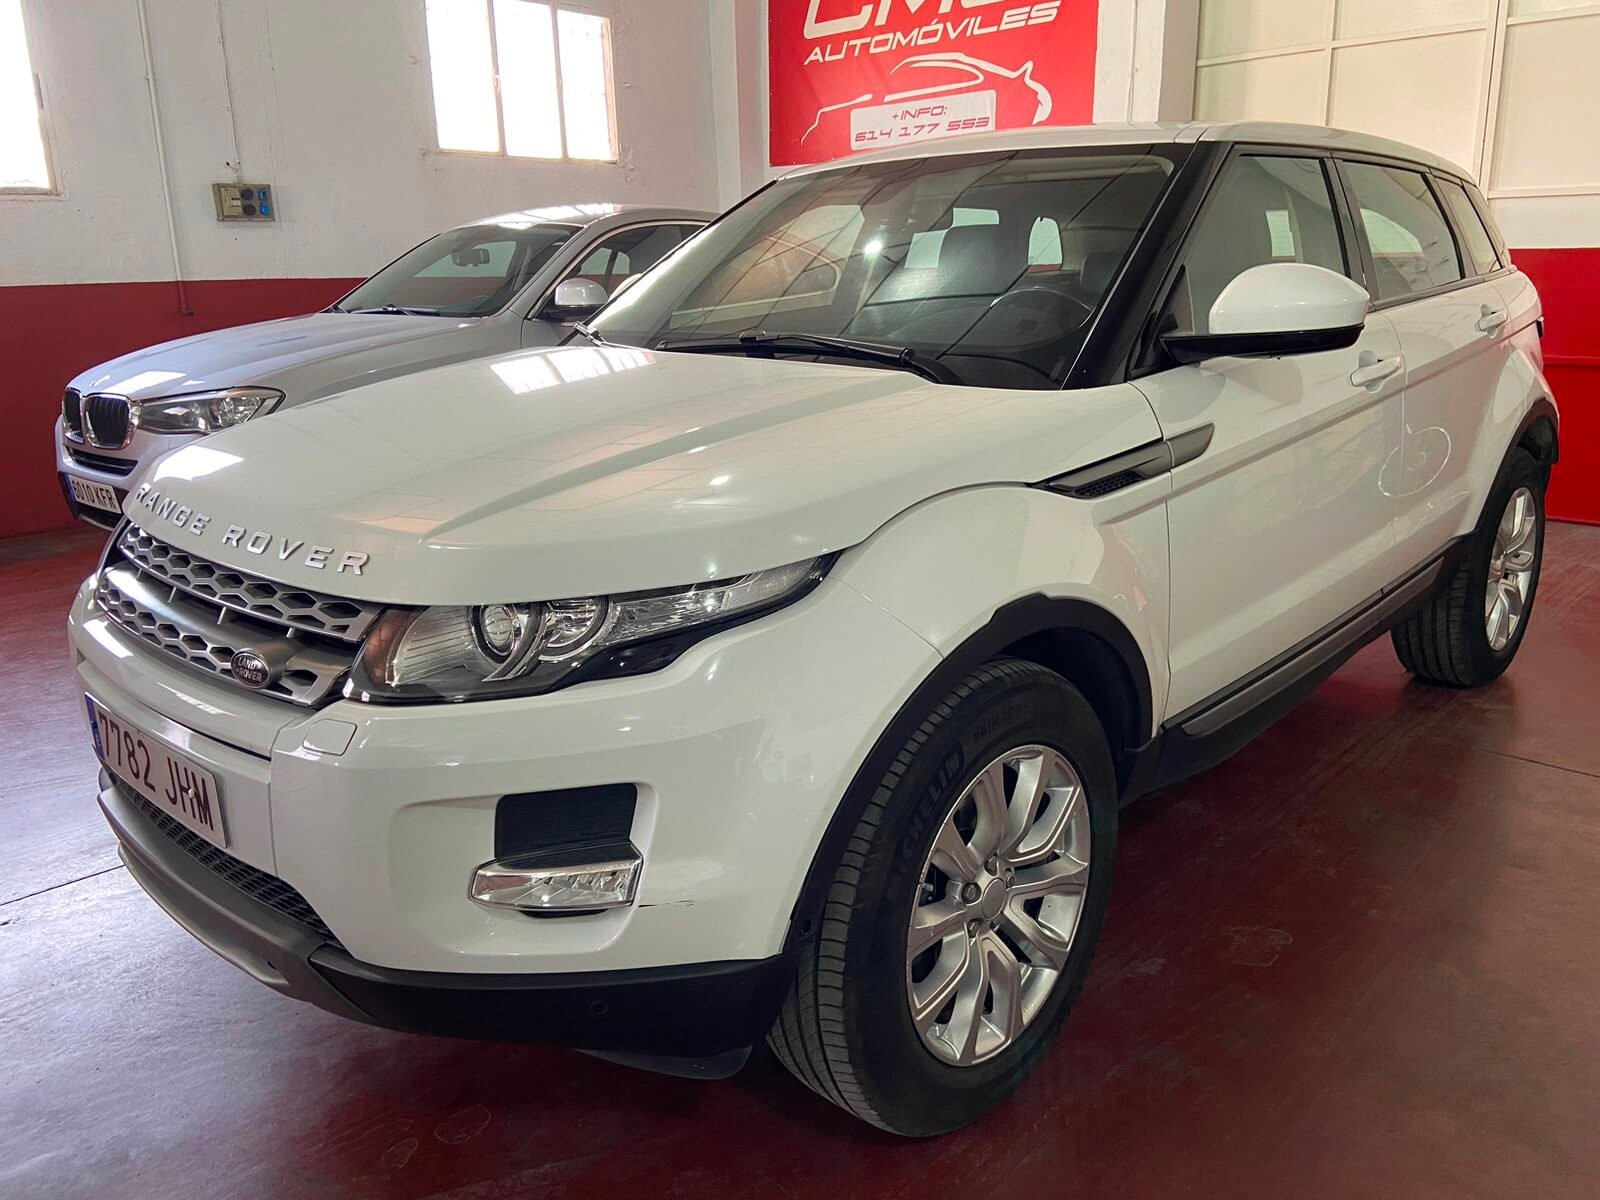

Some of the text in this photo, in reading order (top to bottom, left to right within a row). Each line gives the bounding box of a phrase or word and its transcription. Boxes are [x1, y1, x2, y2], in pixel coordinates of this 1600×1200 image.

[803, 0, 1061, 65] AUTOMÓVILES
[804, 0, 1006, 39] CM
[855, 129, 892, 142] 614
[898, 122, 940, 138] 177
[93, 486, 117, 510] KFR
[136, 482, 370, 576] RANGE ROVER
[237, 656, 258, 671] LAND
[239, 667, 263, 683] ROVER
[98, 710, 214, 832] 7782 JHM
